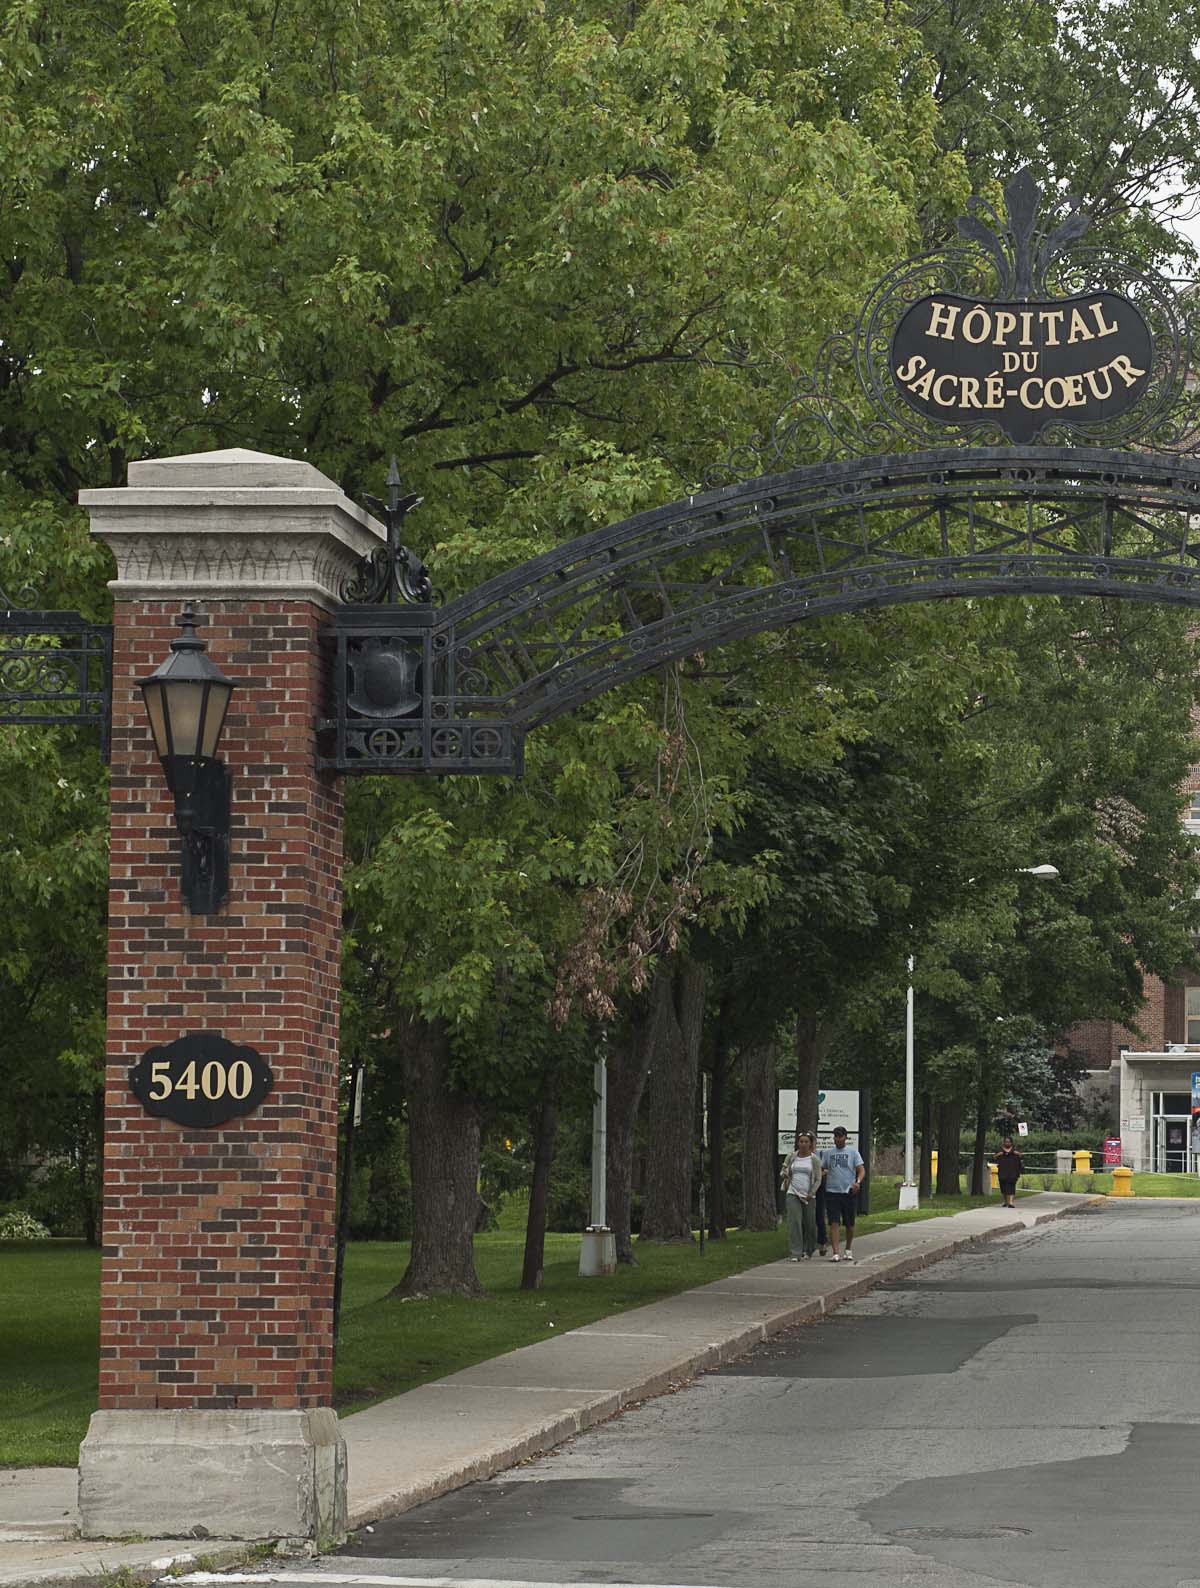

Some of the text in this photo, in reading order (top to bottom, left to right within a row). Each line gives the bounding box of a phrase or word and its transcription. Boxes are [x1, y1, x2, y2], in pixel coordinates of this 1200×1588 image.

[925, 302, 1118, 346] HÔPITAL
[1003, 352, 1039, 373] DU
[149, 1060, 253, 1101] 5400
